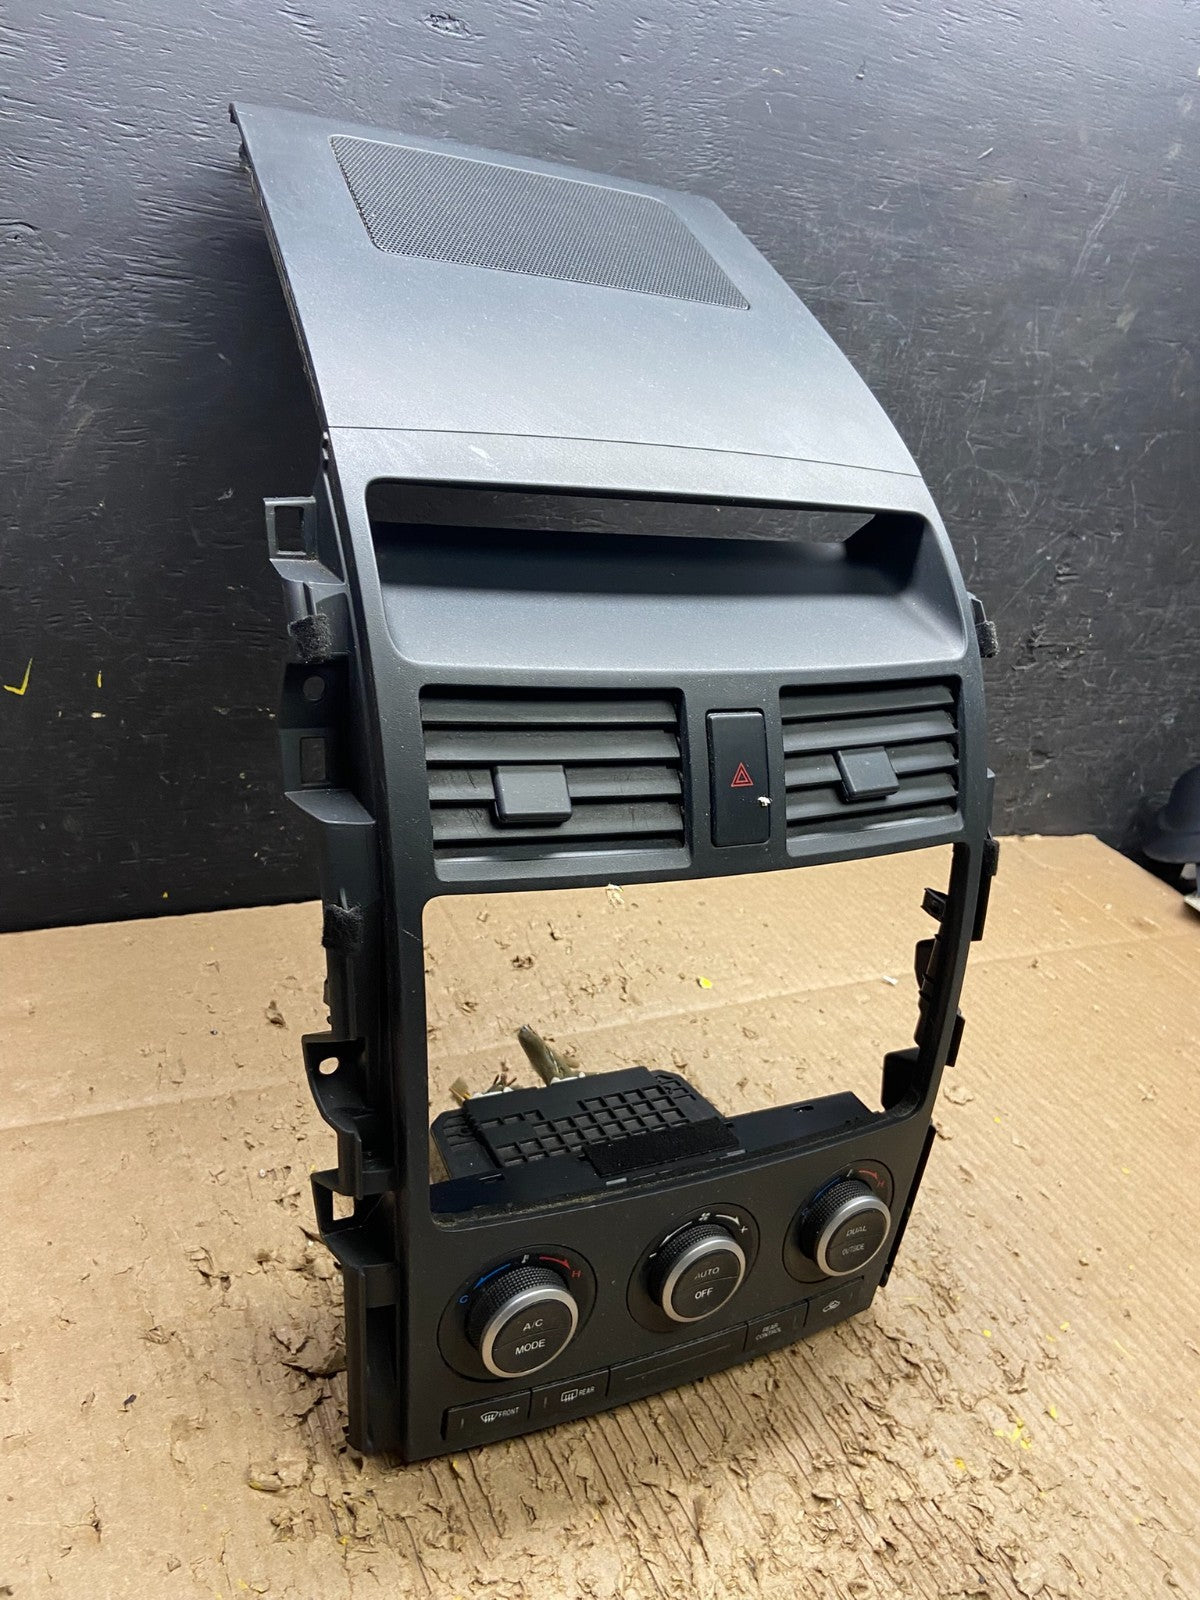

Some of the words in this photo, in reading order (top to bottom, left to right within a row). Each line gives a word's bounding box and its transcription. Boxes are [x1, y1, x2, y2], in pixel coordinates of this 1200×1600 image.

[845, 1225, 867, 1237] DUAL
[571, 1269, 583, 1278] H
[694, 1266, 720, 1280] AUTO
[694, 1287, 714, 1300] OFF
[522, 1318, 544, 1331] A/C
[515, 1338, 546, 1355] MODE
[578, 1386, 596, 1397] REAR
[499, 1406, 520, 1418] FRONT
